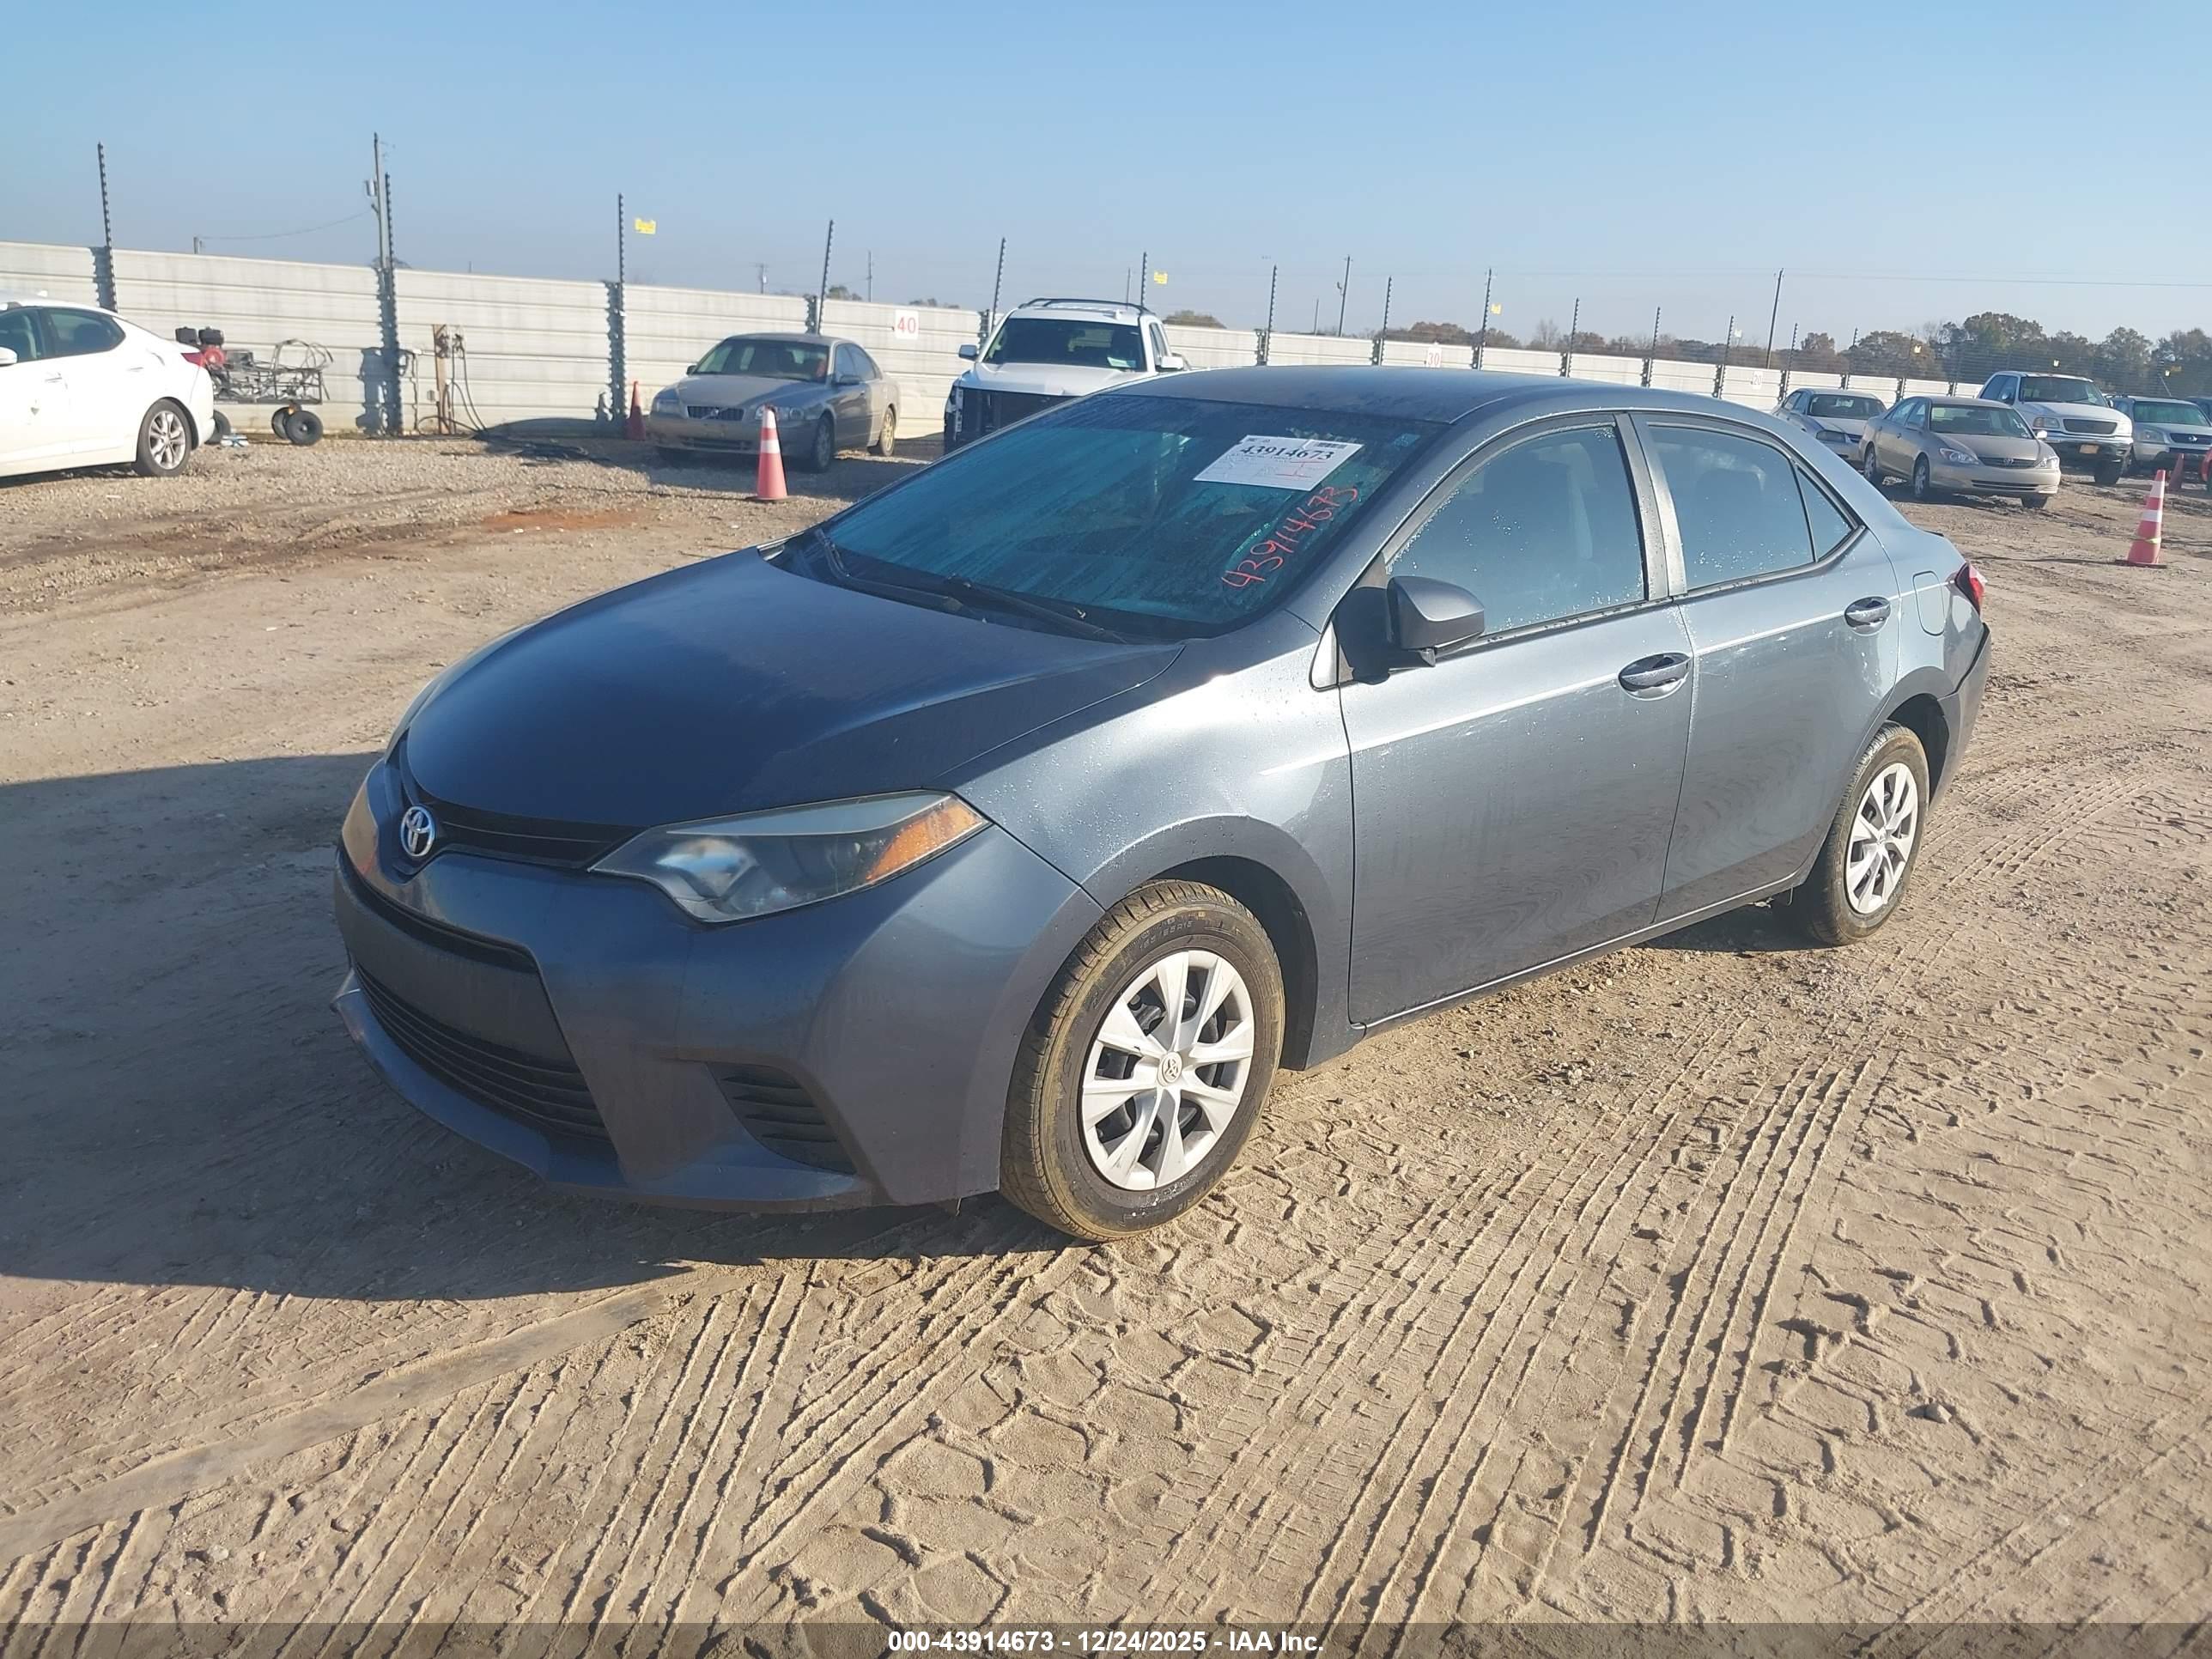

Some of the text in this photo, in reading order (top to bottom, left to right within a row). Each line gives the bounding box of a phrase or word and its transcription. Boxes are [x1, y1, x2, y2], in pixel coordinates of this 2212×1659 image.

[897, 316, 916, 334] 40
[1240, 445, 1336, 461] 43914673
[1221, 486, 1358, 588] 43914673
